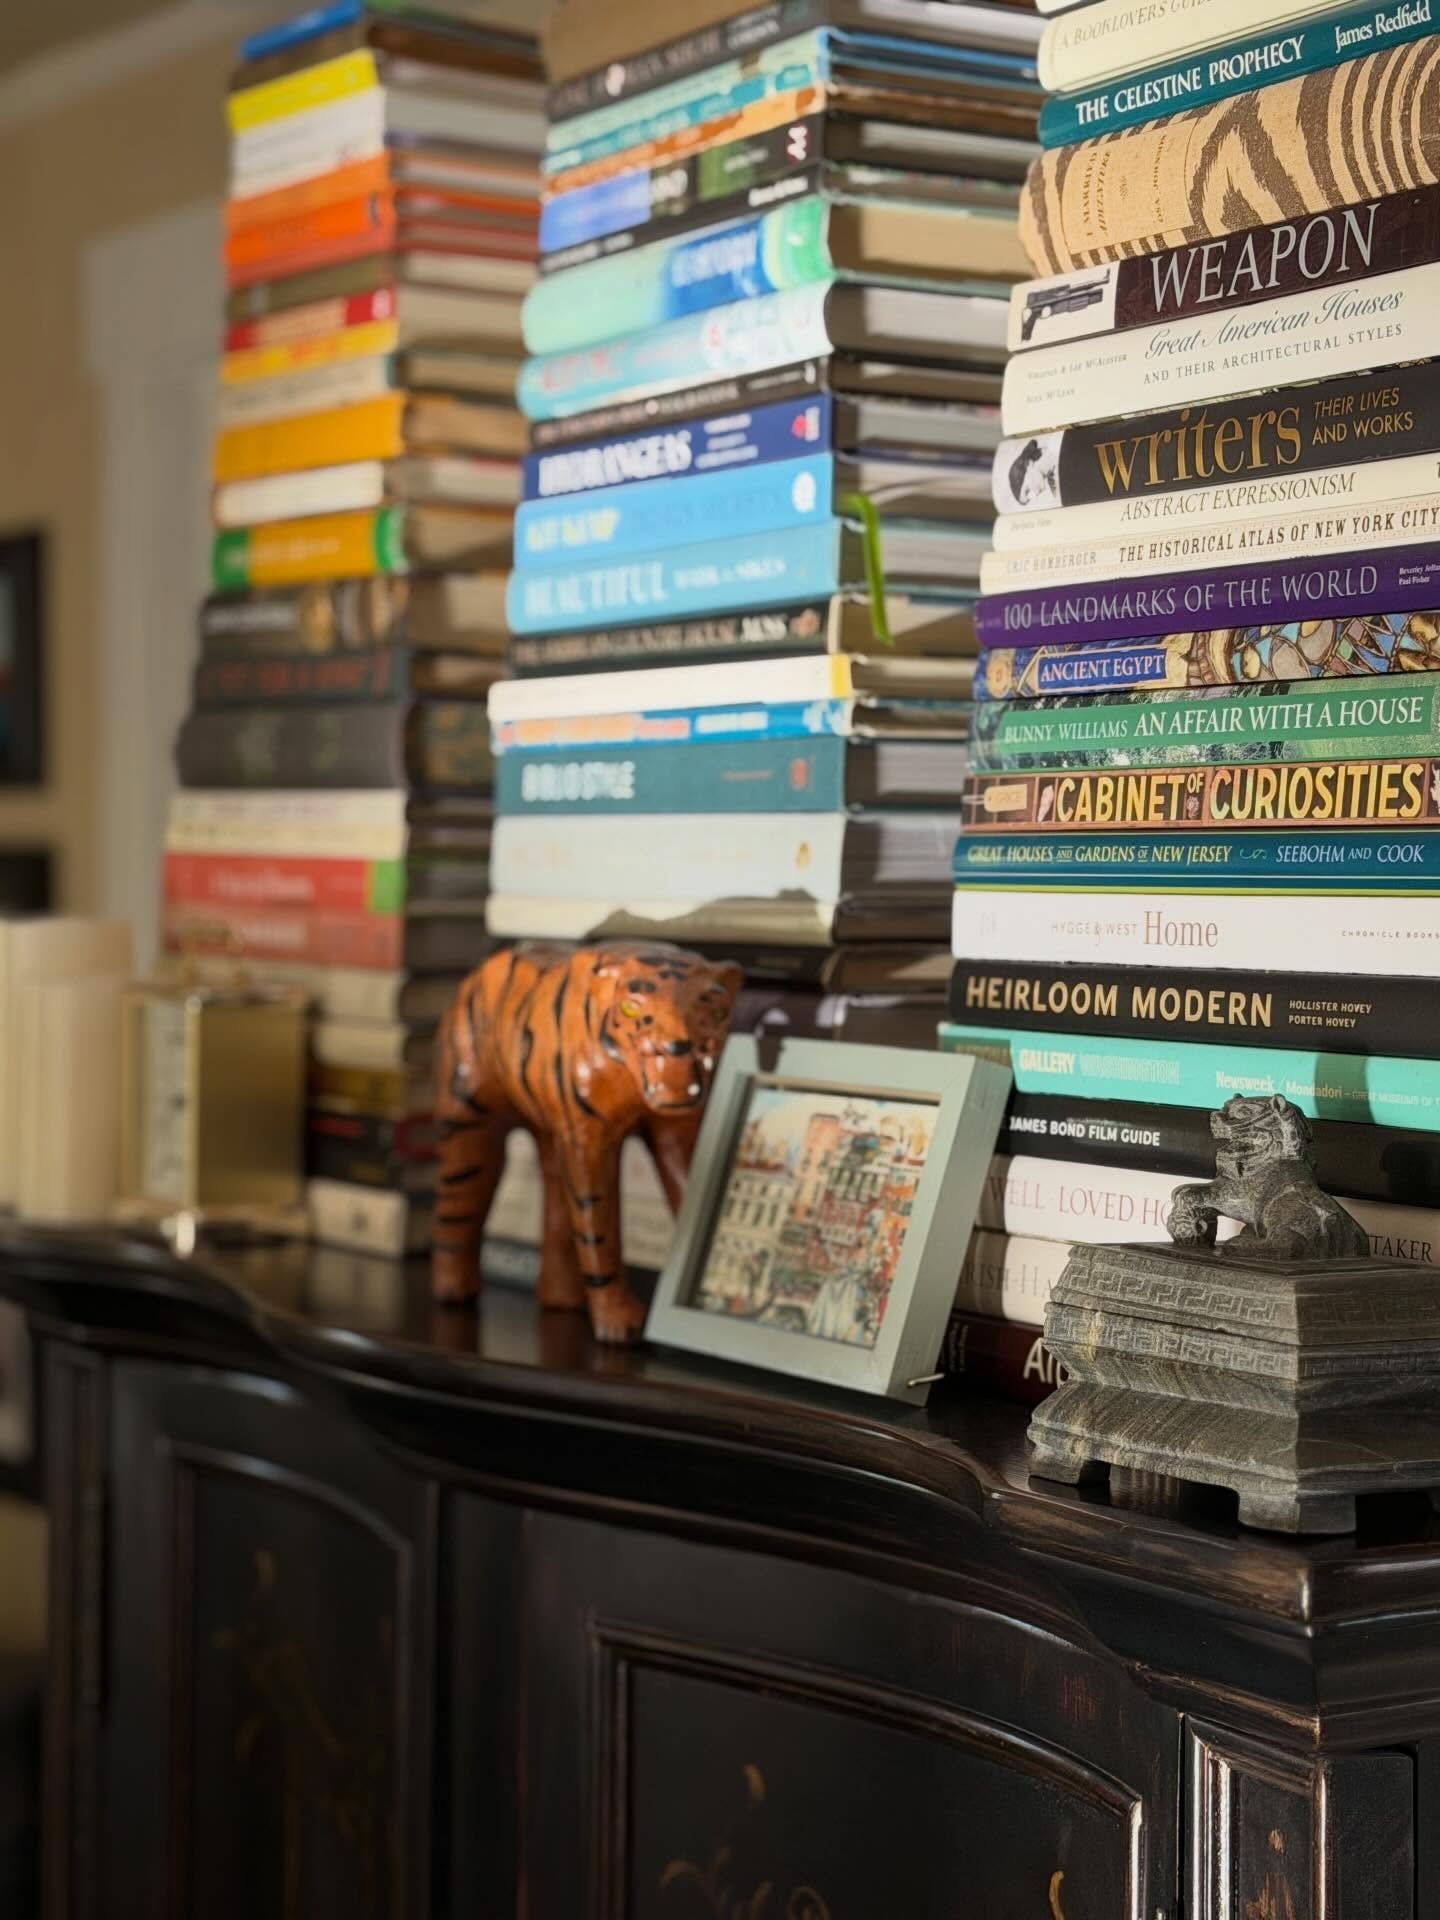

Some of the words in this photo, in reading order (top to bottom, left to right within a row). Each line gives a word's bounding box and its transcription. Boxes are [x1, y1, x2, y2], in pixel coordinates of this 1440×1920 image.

[1335, 23, 1373, 53] James
[1374, 0, 1431, 36] Redfield
[1075, 96, 1109, 125] THE
[1114, 67, 1202, 112] CELESTINE
[1208, 35, 1304, 86] PROPHECY
[1150, 202, 1383, 313] WEAPON
[1145, 329, 1200, 360] Great
[1201, 310, 1311, 347] American
[1314, 288, 1406, 326] Houses
[1144, 367, 1169, 385] AND
[1176, 359, 1216, 379] THEIR
[1222, 339, 1341, 370] ARCHITECTURAL
[1347, 323, 1403, 345] STYLES
[1313, 395, 1356, 420] THEIR
[1360, 386, 1400, 411] LIVES
[1094, 406, 1301, 496] writers
[1312, 423, 1346, 447] AND
[1352, 410, 1414, 438] WORKS
[1120, 490, 1207, 522] ABSTRACT
[1212, 470, 1357, 511] EXPRESSIONISM
[1119, 545, 1143, 564] THE
[1149, 533, 1234, 562] HISTORICAL
[1240, 528, 1285, 549] ATLAS
[1290, 523, 1310, 543] OF
[1315, 519, 1347, 540] NEW
[1353, 512, 1395, 534] YORK
[1401, 506, 1440, 529] CITY
[1004, 604, 1032, 632] 100
[1040, 586, 1176, 627] LANDMARKS
[1183, 584, 1214, 611] OF
[1224, 579, 1272, 608] THE
[1282, 565, 1378, 600] WORLD
[1040, 658, 1111, 682] ANCIENT
[1113, 652, 1165, 677] EGYPT
[1004, 724, 1055, 745] BUNNY
[1058, 718, 1128, 742] WILLIAMS
[1133, 712, 1168, 737] AN
[1172, 705, 1244, 734] AFFAIR
[1249, 702, 1313, 731] WITH
[1315, 701, 1336, 727] A
[1339, 696, 1424, 726] HOUSE
[1056, 773, 1186, 823] CABINET
[1186, 772, 1204, 794] OF
[1210, 763, 1425, 822] CURIOSITIES
[966, 844, 1003, 863] GREAT
[1007, 844, 1053, 863] HOUSES
[1055, 847, 1073, 860] AND
[1074, 845, 1135, 863] GARDENS
[1137, 845, 1149, 861] OF
[1151, 845, 1184, 863] NEW
[1185, 844, 1233, 866] JERSEY
[1275, 844, 1345, 864] SEEBOHM
[1348, 847, 1372, 861] AND
[1376, 844, 1425, 864] COOK
[1105, 922, 1139, 937] WEST
[1143, 910, 1219, 948] Home
[966, 975, 1118, 1018] HEIRLOOM
[1131, 985, 1272, 1028] MODERN
[1288, 1014, 1324, 1028] PORTER
[1326, 1017, 1356, 1029] HOVEY
[1289, 1000, 1338, 1013] HOLLISTER
[1340, 1002, 1372, 1015] HOVEY
[1019, 1049, 1076, 1075] GALLERY
[1216, 1071, 1275, 1093] Newsweek
[1286, 1080, 1342, 1098] Mondadori
[1009, 1116, 1047, 1134] JAMES
[1050, 1120, 1085, 1139] BOND
[1088, 1125, 1117, 1142] FILM
[1120, 1128, 1161, 1147] GUIDE
[1058, 1185, 1134, 1223] LOVED
